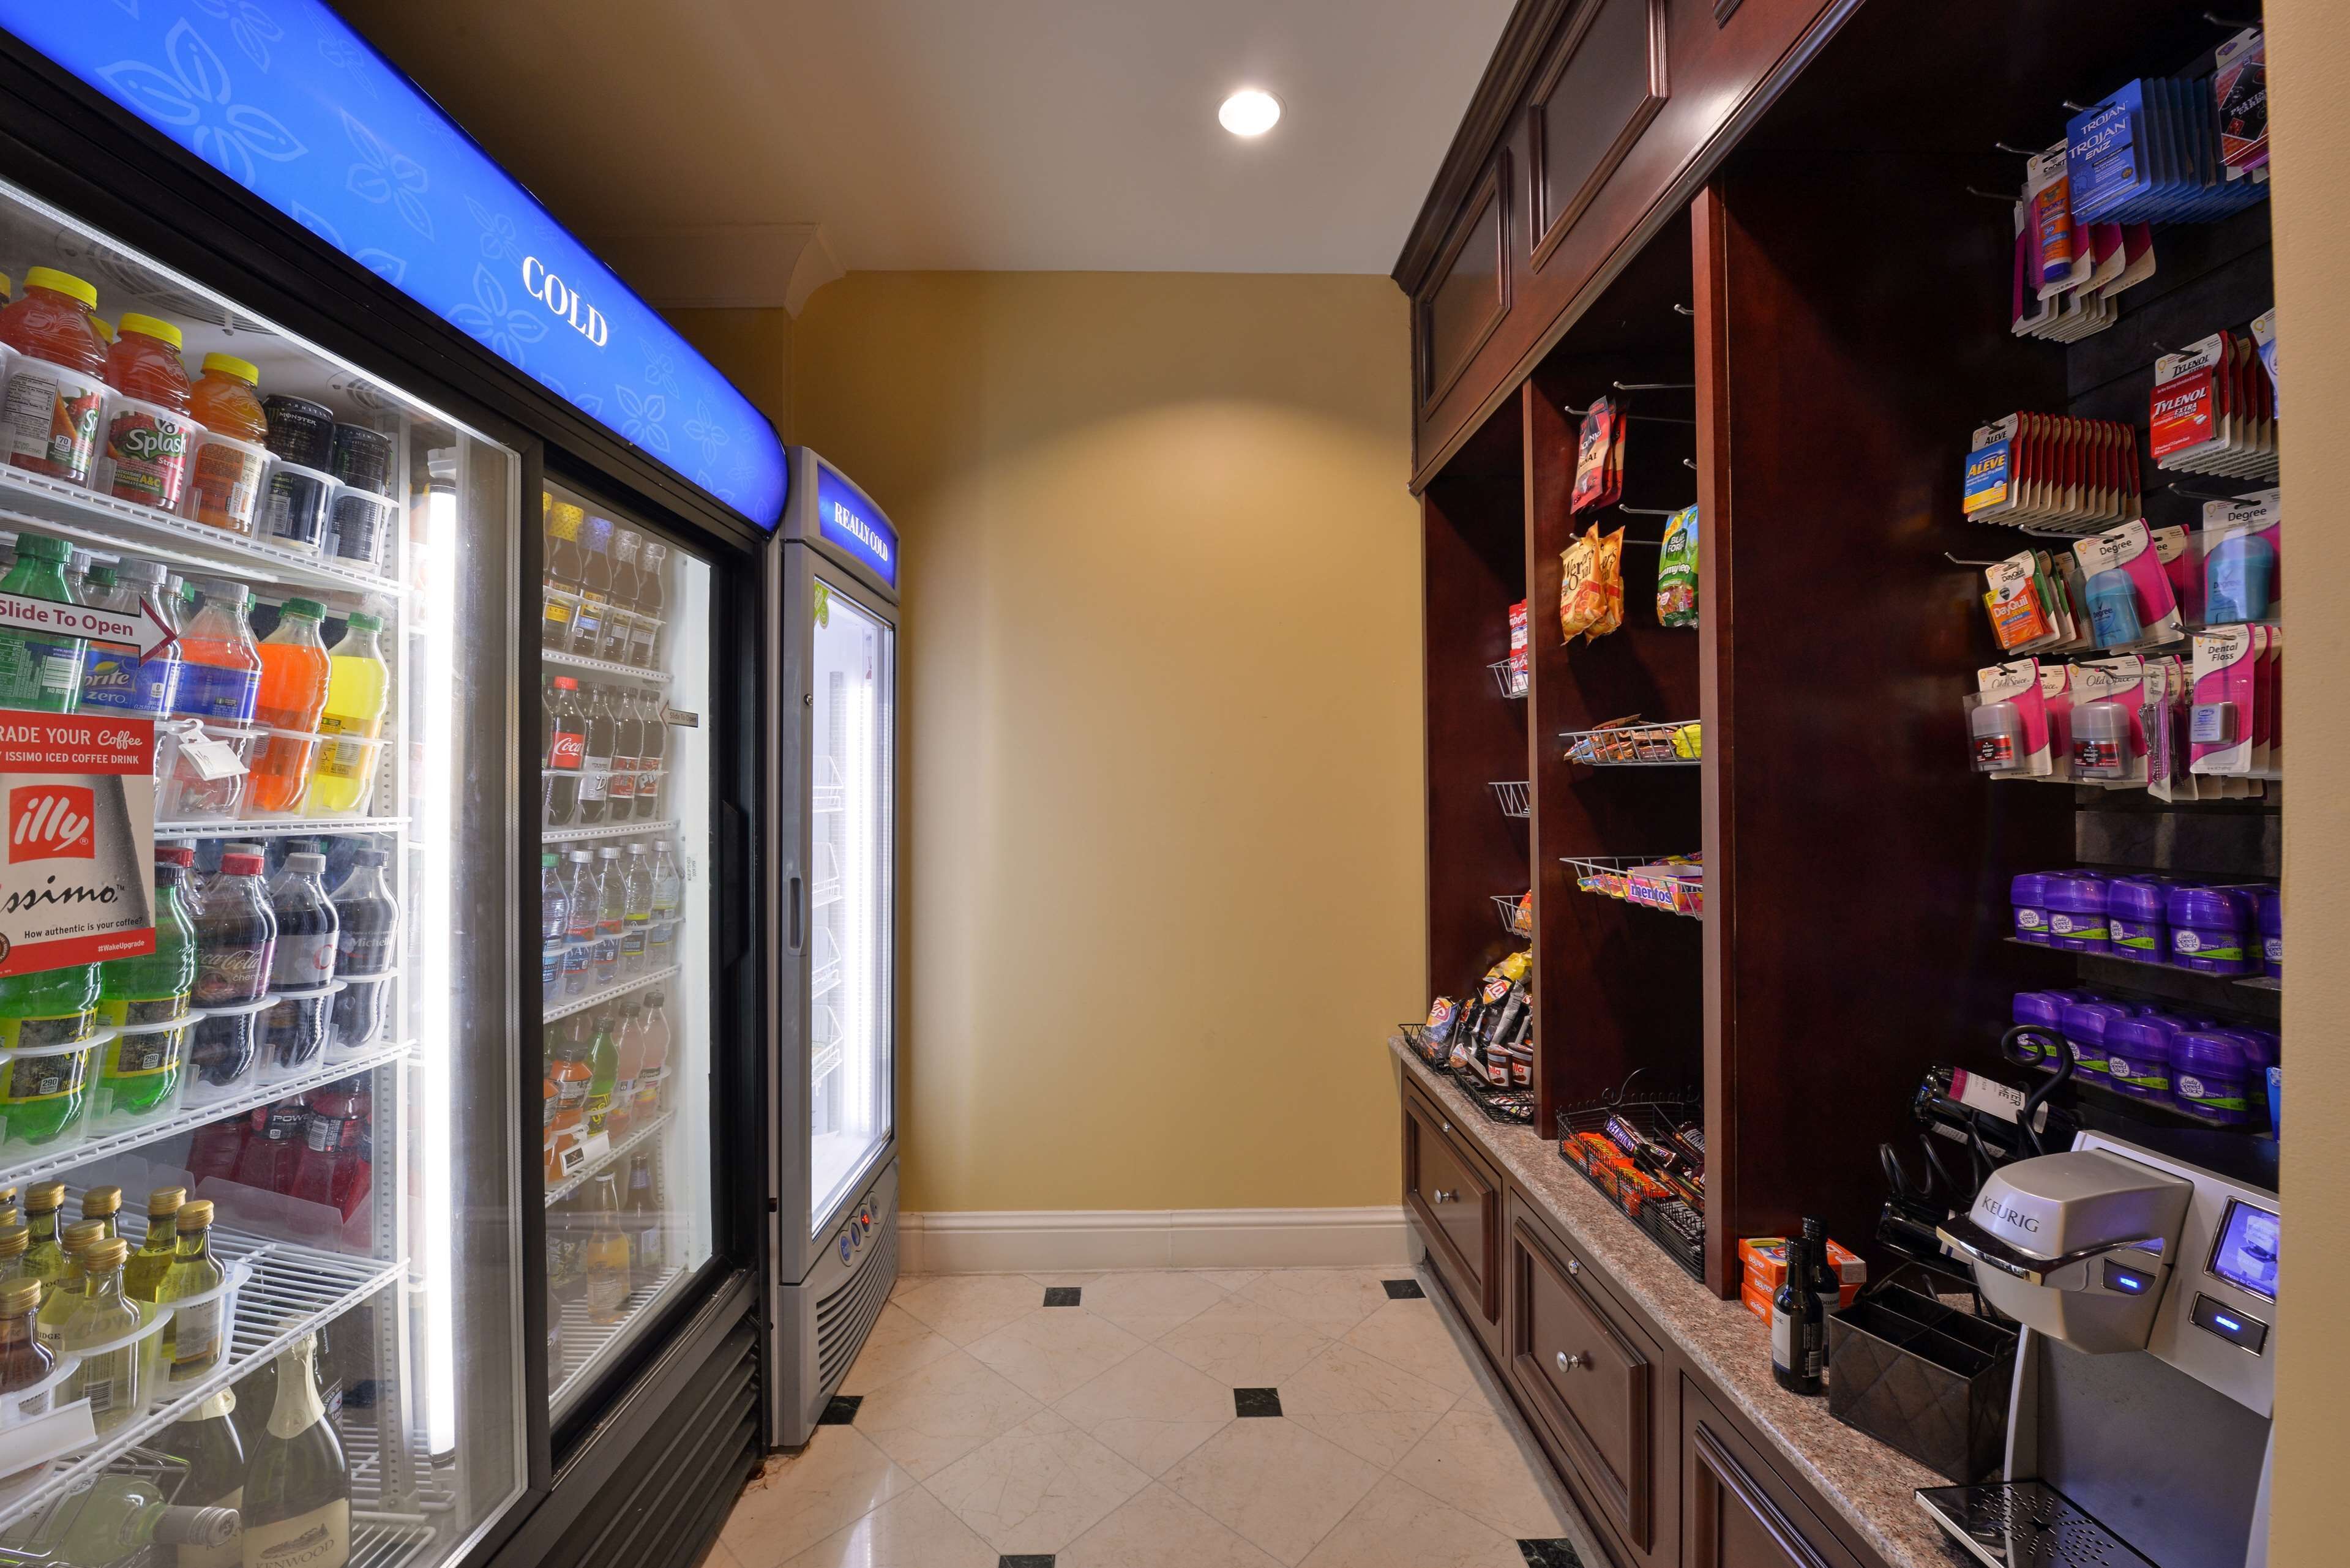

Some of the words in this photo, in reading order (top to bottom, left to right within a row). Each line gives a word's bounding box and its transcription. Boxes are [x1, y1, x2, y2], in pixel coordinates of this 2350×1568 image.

[2081, 102, 2126, 135] TROJAN
[2068, 118, 2126, 159] TROJAN
[2085, 140, 2111, 161] ENZ
[523, 256, 608, 347] COLD
[2172, 354, 2209, 378] TYLENOL
[2152, 387, 2207, 420] TYLENOL
[2174, 402, 2196, 415] EXTRA
[279, 411, 317, 426] MONSTER
[59, 436, 69, 445] 70
[126, 429, 187, 458] Splash
[1984, 430, 2008, 446] ALEVE
[1967, 454, 2007, 479] ALEVE
[140, 473, 161, 487] A&C
[2228, 507, 2267, 521] Degree
[834, 501, 869, 545] REALLY
[869, 530, 888, 562] COLD
[2099, 538, 2133, 556] Degree
[1994, 595, 2029, 618] DayQuil
[53, 610, 77, 627] To
[82, 614, 133, 636] Open
[2207, 643, 2238, 655] Dental
[2212, 652, 2234, 662] Floss
[1991, 678, 2009, 689] Old
[2086, 674, 2105, 687] Old
[87, 691, 126, 704] zero
[670, 711, 680, 720] Slide
[686, 714, 697, 723] Open
[46, 727, 91, 745] YOUR
[97, 730, 143, 750] Coffee
[6, 752, 42, 762] ISSIMO
[46, 753, 69, 763] ICED
[72, 754, 108, 764] COFFEE
[111, 755, 139, 764] DRINK
[14, 796, 89, 851] illy
[1631, 883, 1672, 905] mentos
[24, 929, 42, 939] How
[45, 924, 85, 936] authentic
[97, 922, 114, 931] your
[116, 917, 143, 927] coffee?
[97, 940, 145, 952] #WakeUpgrade
[144, 1054, 158, 1062] 290
[42, 1078, 58, 1088] 290
[1981, 1196, 2040, 1233] KEURIG
[2223, 1270, 2239, 1282] Press
[2246, 1281, 2271, 1296] Continue
[255, 1539, 335, 1568] KENWOOD
